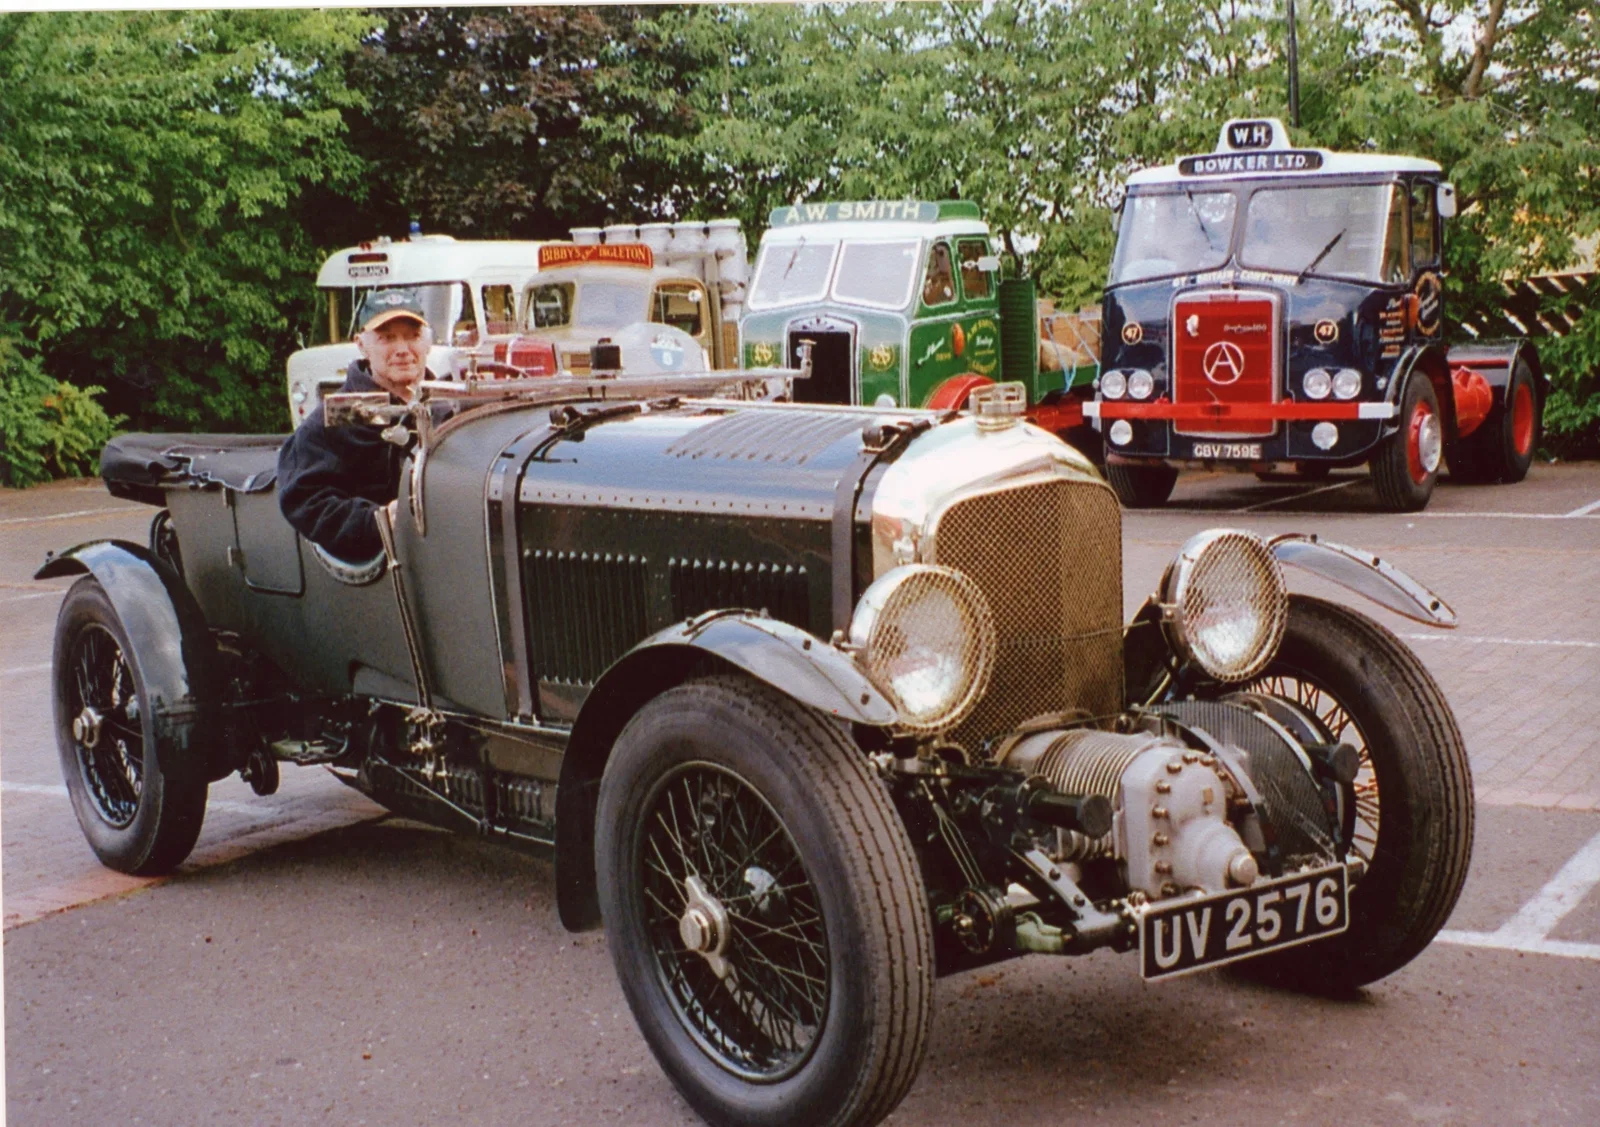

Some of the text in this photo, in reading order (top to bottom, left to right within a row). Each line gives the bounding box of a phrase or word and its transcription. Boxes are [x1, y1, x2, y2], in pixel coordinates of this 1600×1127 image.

[1194, 155, 1268, 173] BOWKER
[837, 201, 920, 219] SMITH
[1125, 327, 1138, 339] 47
[1318, 325, 1333, 337] 47
[1154, 878, 1338, 969] UV 2576
